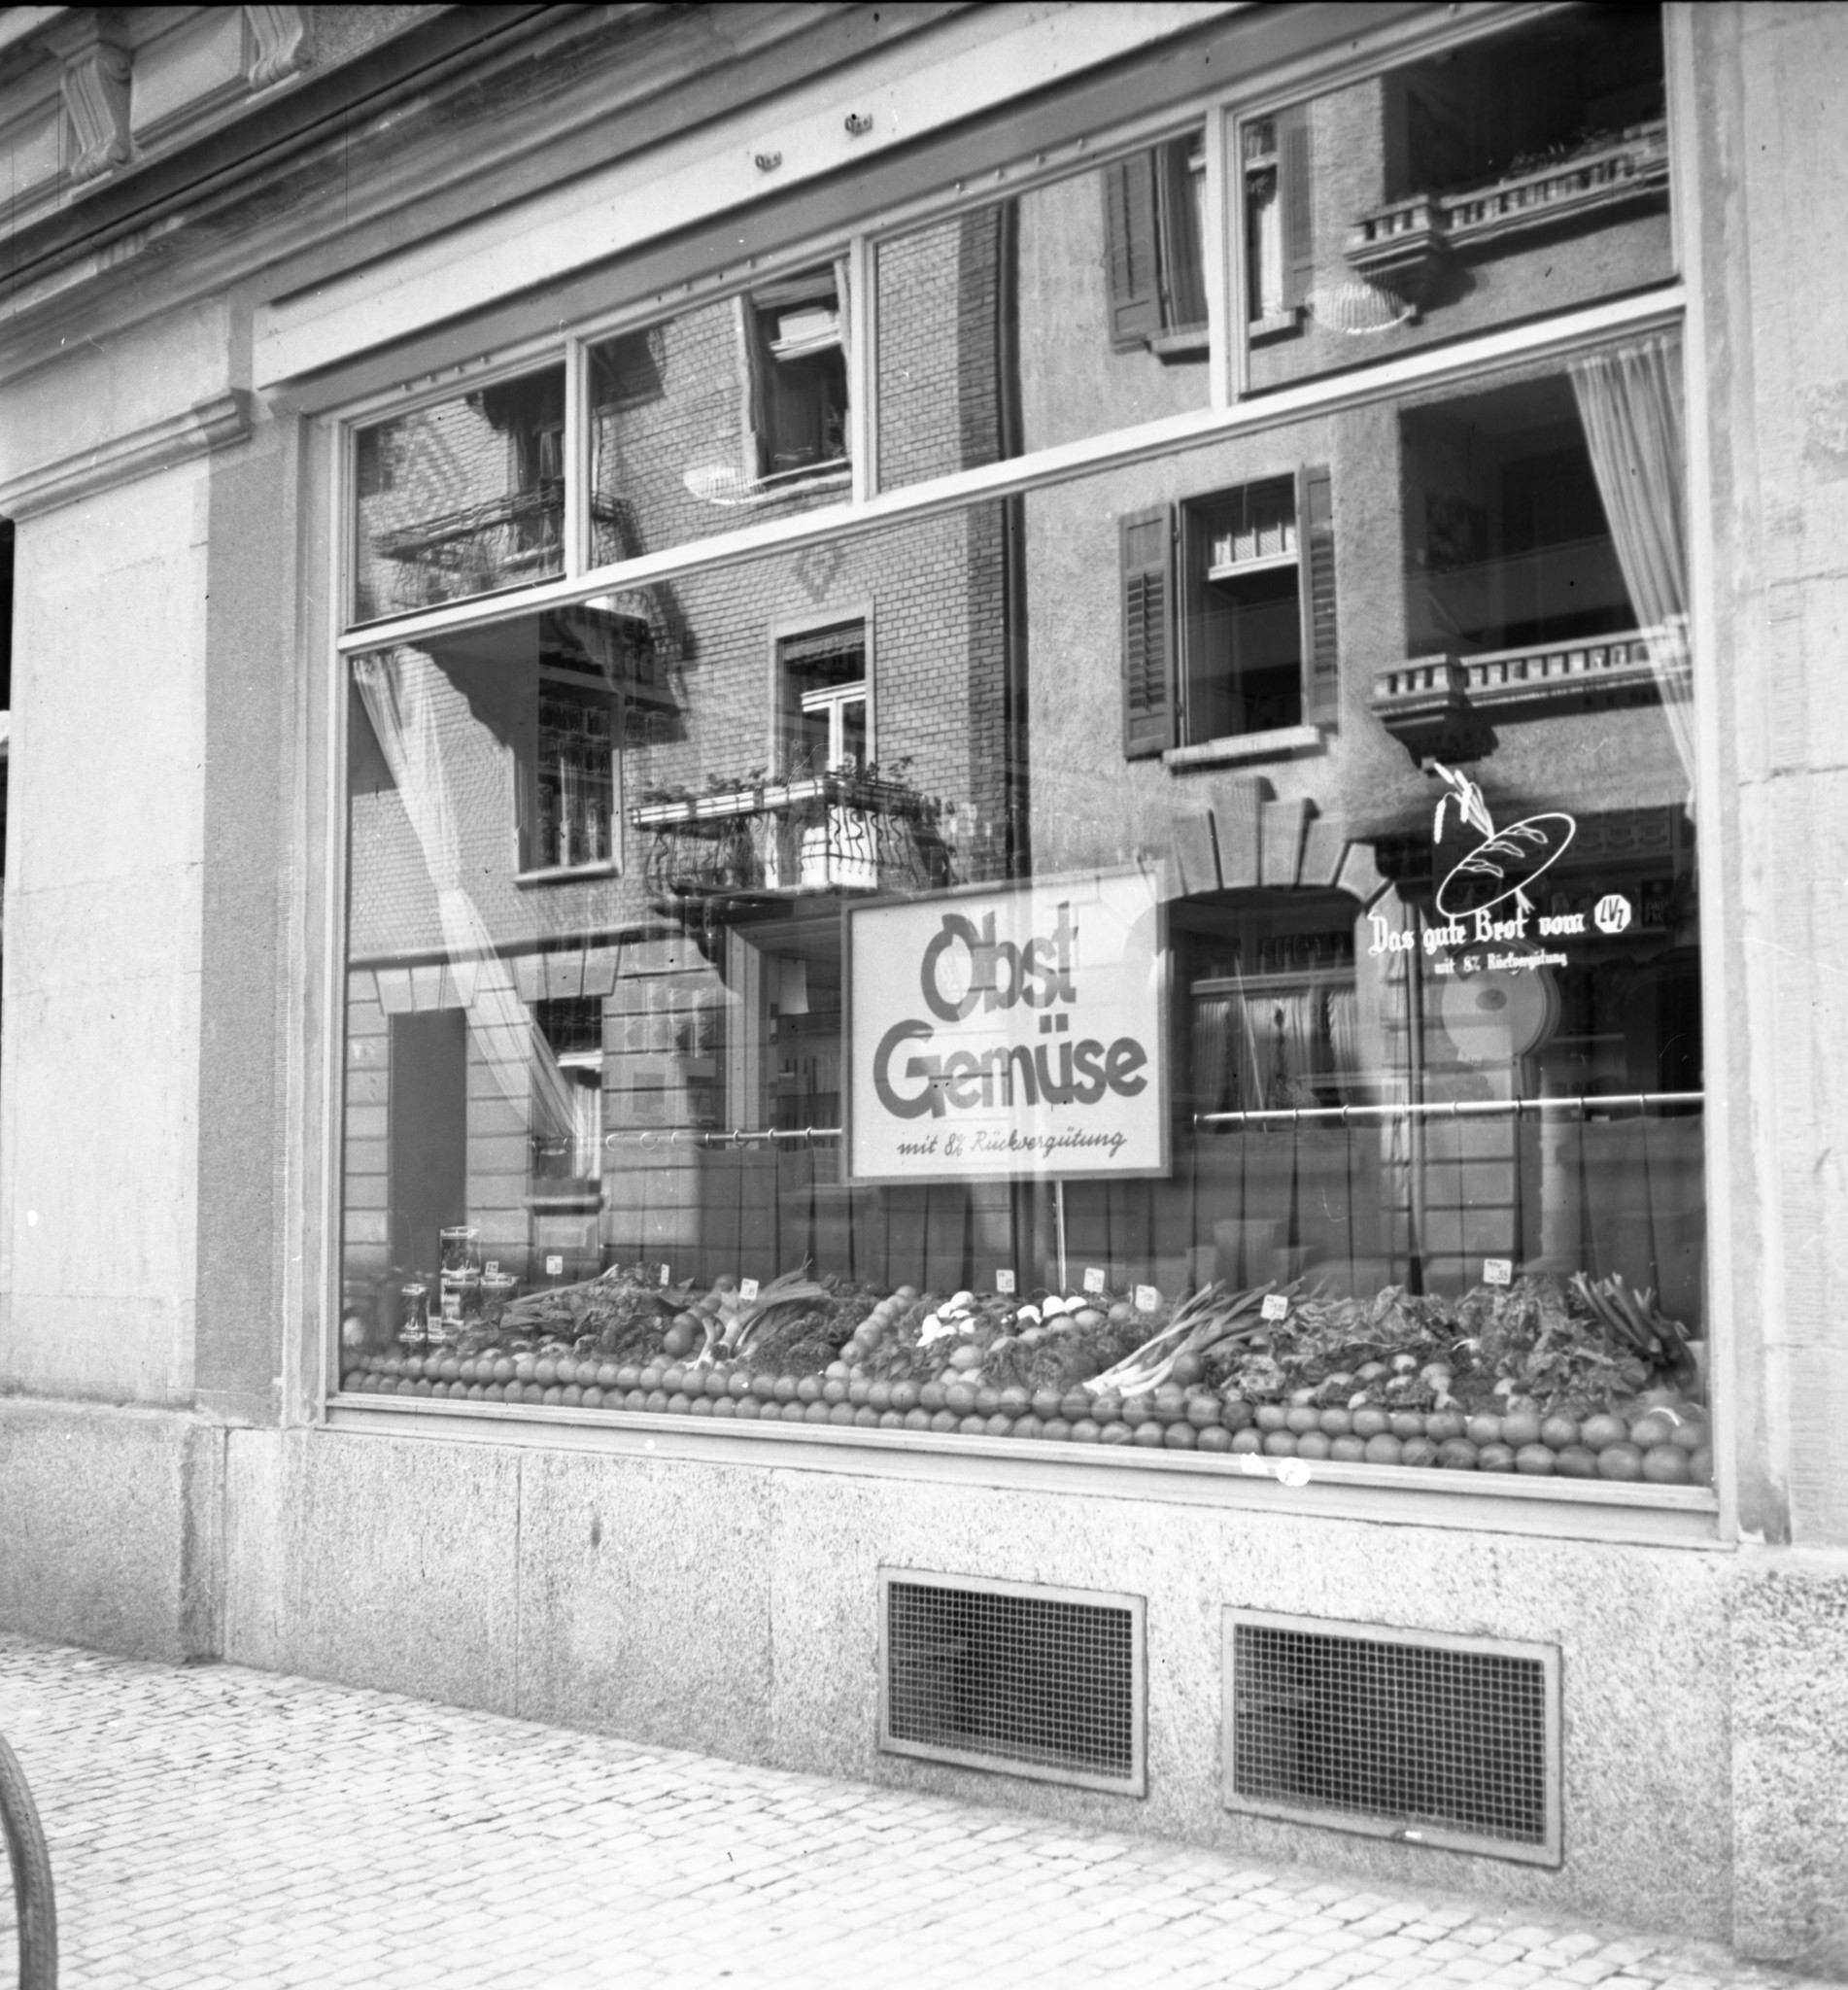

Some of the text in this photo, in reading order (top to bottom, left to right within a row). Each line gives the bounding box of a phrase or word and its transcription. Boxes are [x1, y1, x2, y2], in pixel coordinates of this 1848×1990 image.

[1367, 909, 1415, 956] Das
[1422, 913, 1467, 955] gute
[1474, 907, 1529, 942] Brot
[1538, 912, 1587, 937] vom
[921, 900, 1078, 1022] Obst
[1434, 947, 1568, 975] mit 8% Rückvergütung
[873, 1012, 1148, 1119] Gemüse
[897, 1126, 1128, 1158] mit 8% Rückvergütung
